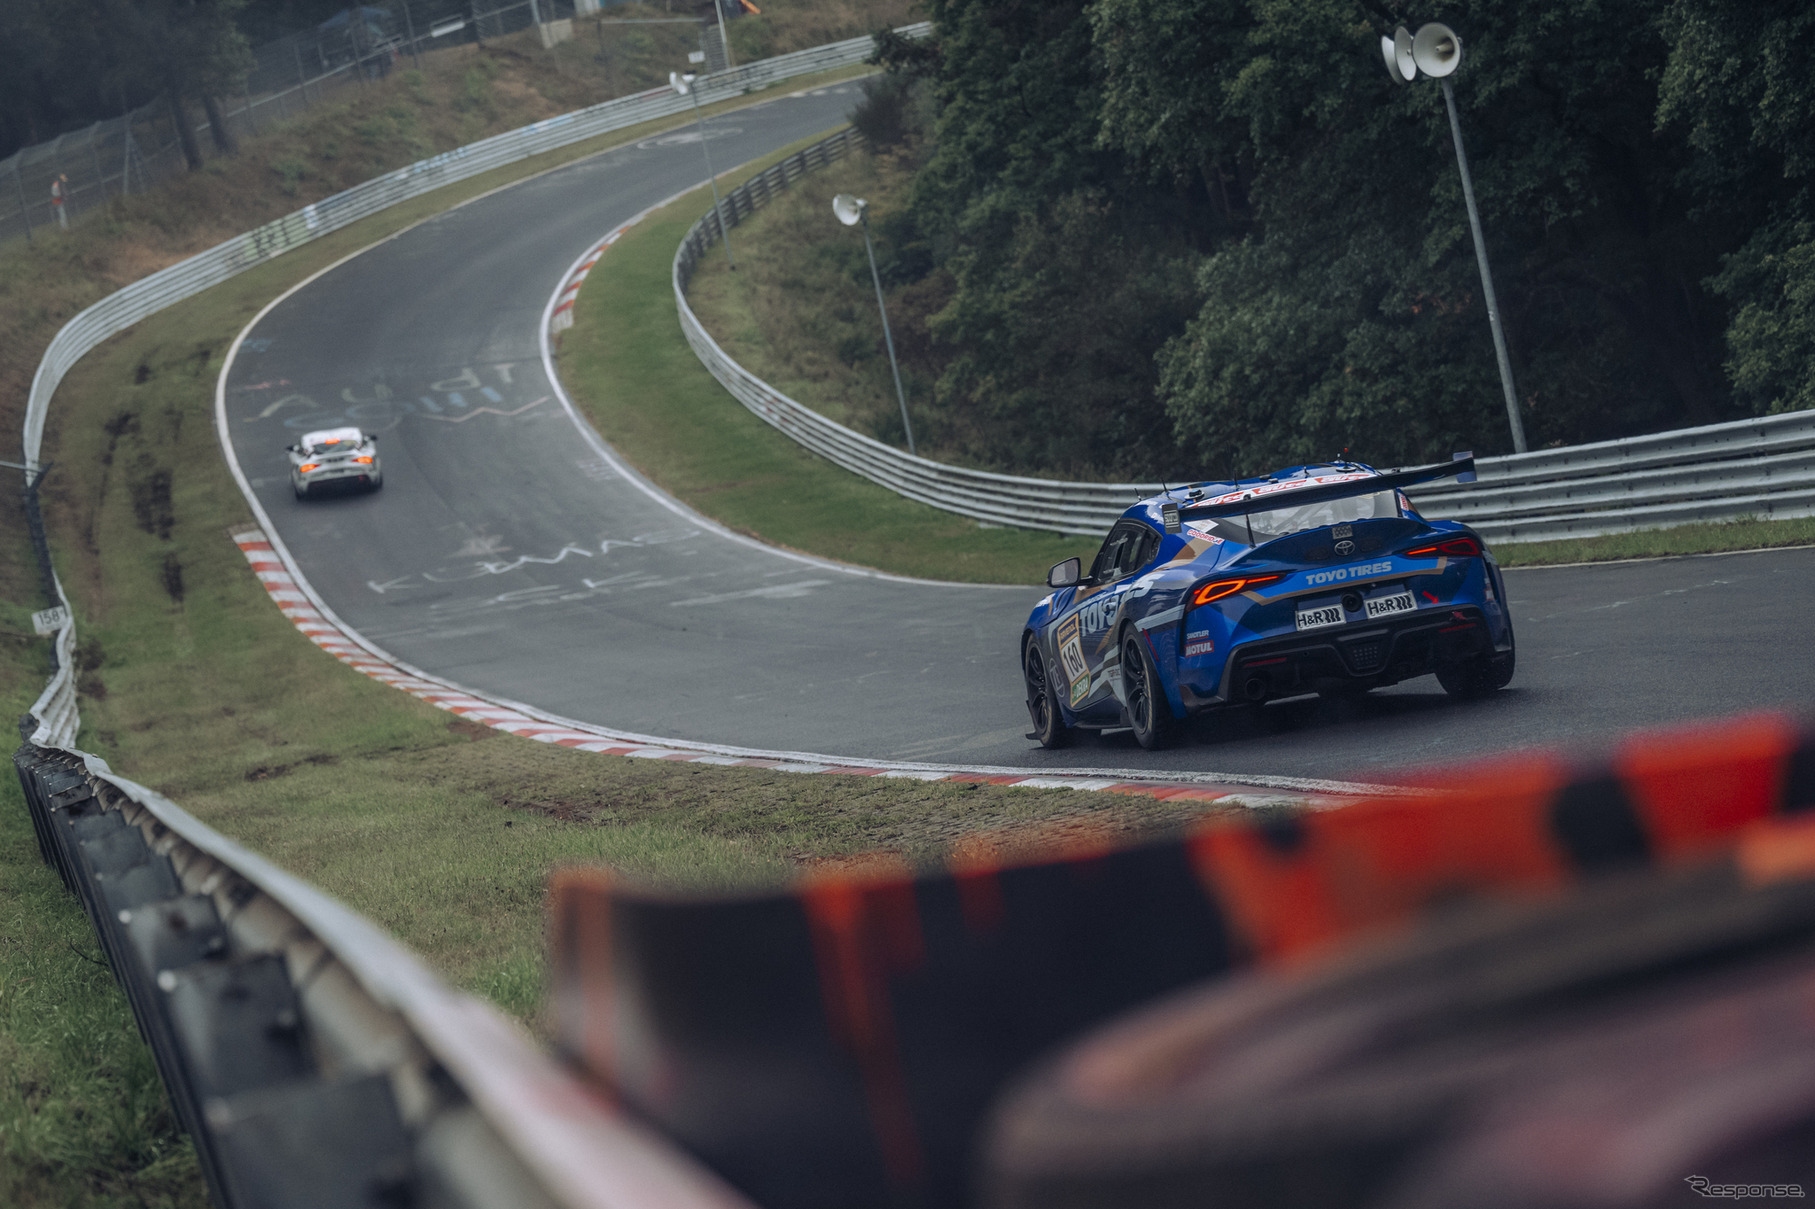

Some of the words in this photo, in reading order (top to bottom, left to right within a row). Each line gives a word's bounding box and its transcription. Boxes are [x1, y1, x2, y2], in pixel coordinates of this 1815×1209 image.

[1305, 569, 1346, 585] TOYO
[1348, 561, 1392, 578] TIRES
[1367, 598, 1396, 616] H&R
[1296, 610, 1324, 628] H&R
[1185, 642, 1213, 657] MOTUL
[1063, 641, 1084, 677] 160
